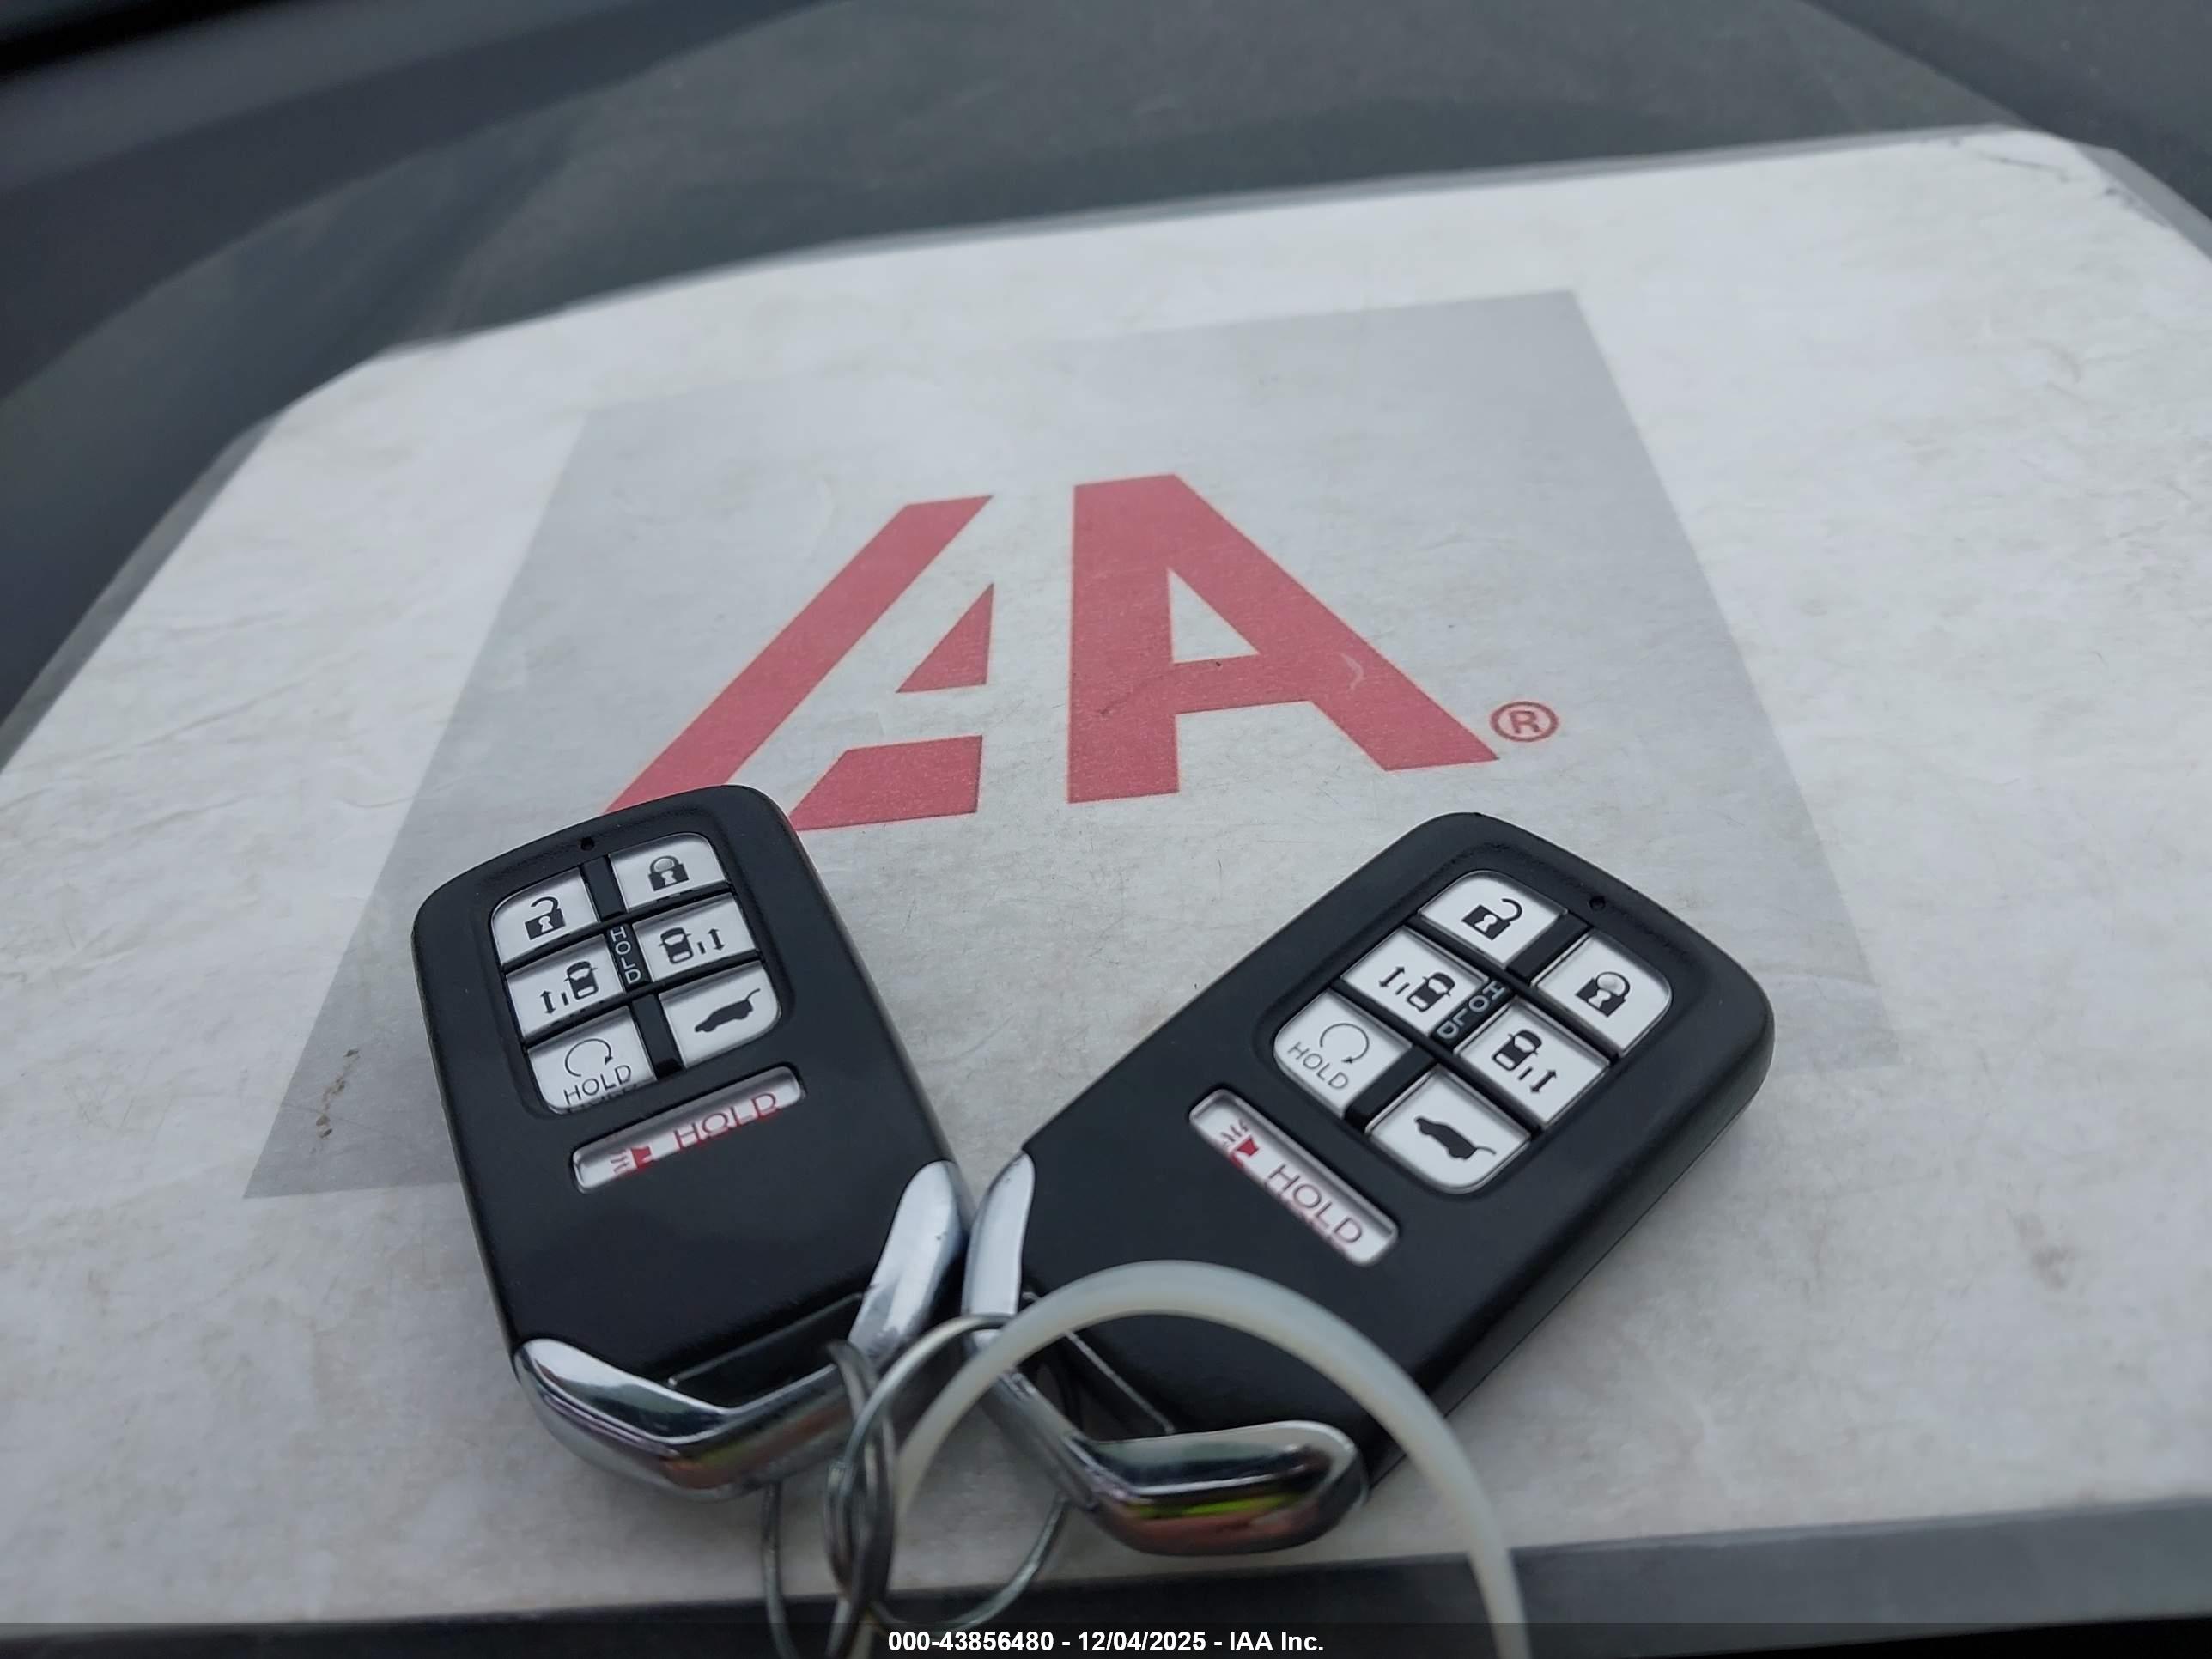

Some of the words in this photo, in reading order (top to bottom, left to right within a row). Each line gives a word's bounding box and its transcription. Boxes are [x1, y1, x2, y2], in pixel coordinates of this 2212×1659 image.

[609, 925, 642, 985] HOLD
[1437, 981, 1504, 1040] HOLD
[563, 1064, 632, 1106] HOLD
[1288, 1042, 1349, 1091] HOLD
[673, 1092, 778, 1150] HOLD
[1267, 1164, 1363, 1245] HOLD
